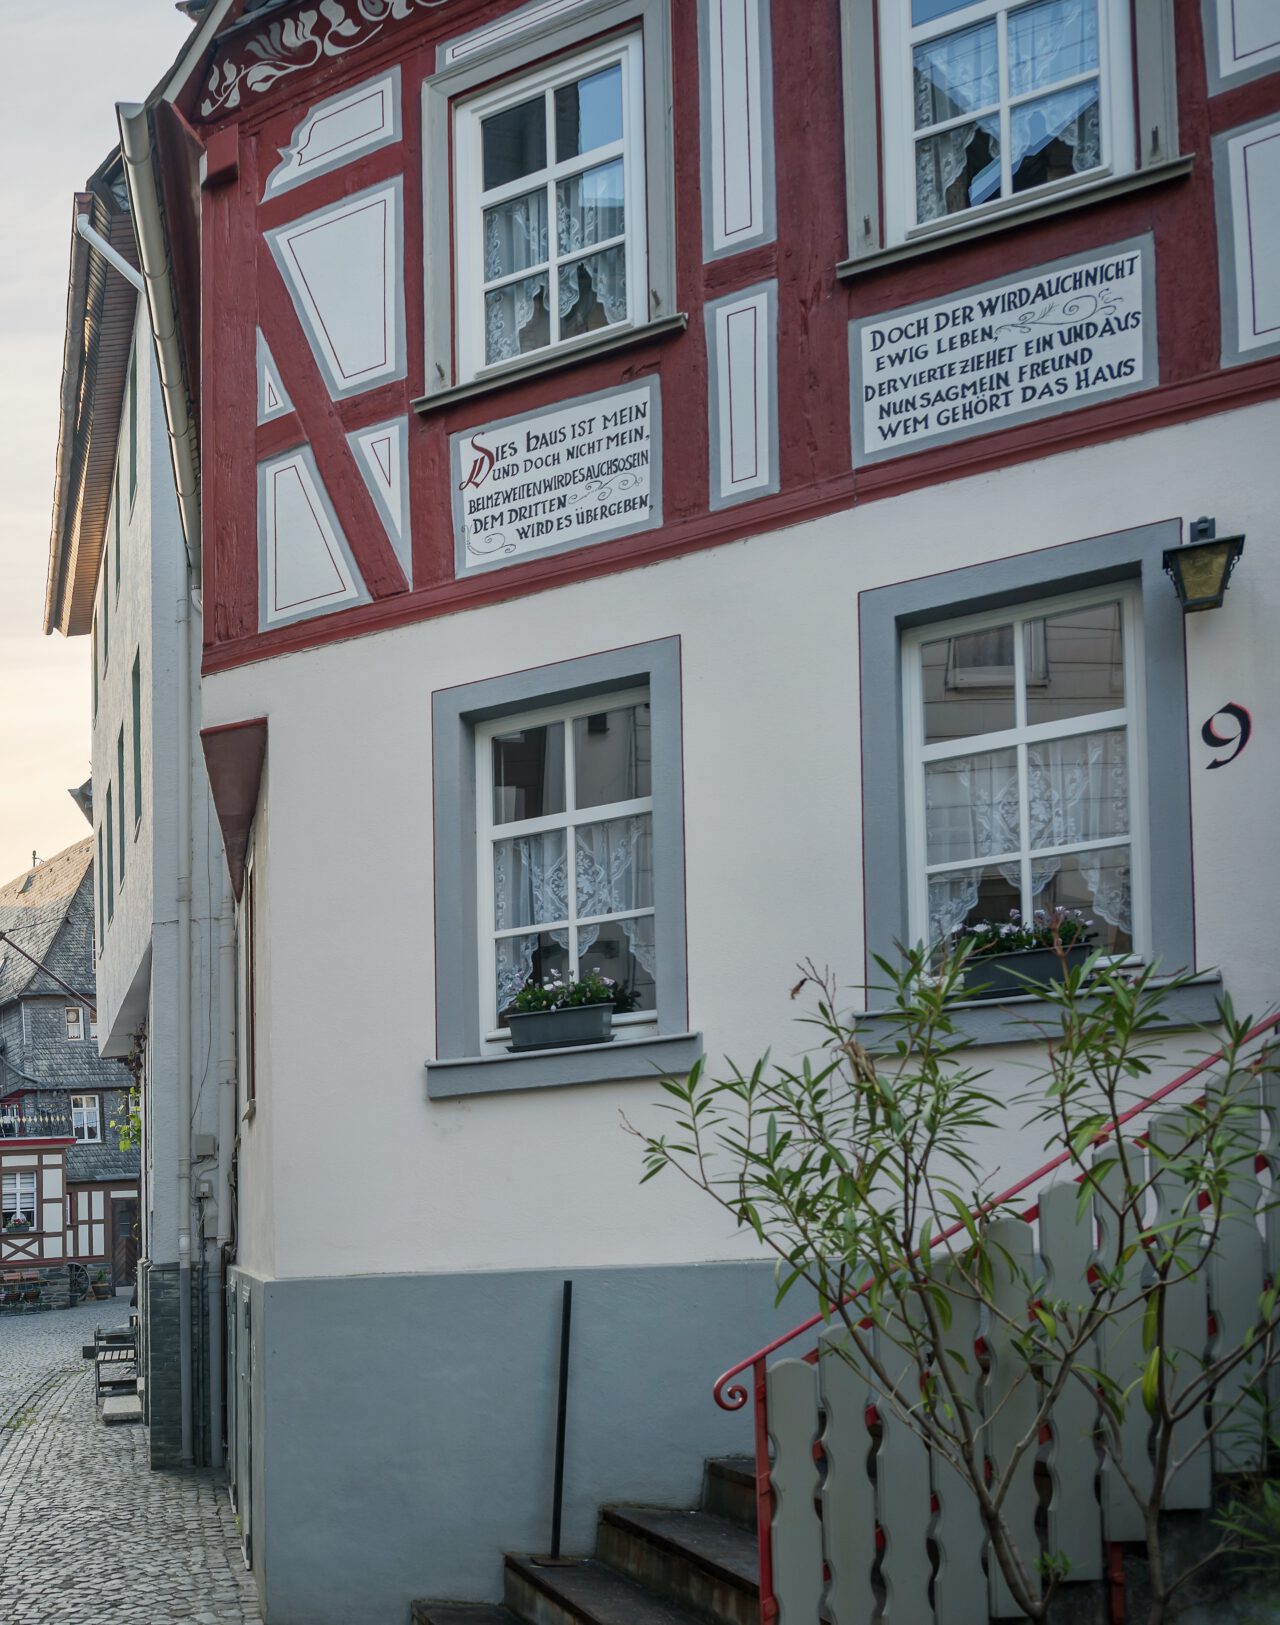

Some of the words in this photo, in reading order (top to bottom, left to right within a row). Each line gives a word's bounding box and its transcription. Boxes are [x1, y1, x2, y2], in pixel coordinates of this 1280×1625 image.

[869, 317, 929, 352] DOCH
[933, 305, 975, 333] DER
[977, 286, 1031, 319] WIRD
[1029, 269, 1084, 305] AUCH
[1085, 254, 1140, 288] NICHT
[864, 378, 899, 402] DER
[899, 362, 957, 389] VIERTE
[958, 344, 1018, 375] ZIEHET
[1024, 333, 1054, 357] EIN
[1057, 321, 1098, 346] UND
[1098, 311, 1142, 338] AUS
[875, 344, 929, 372] EWIG
[936, 325, 998, 355] LEBEN,
[877, 413, 929, 441] WEM
[937, 390, 1014, 426] GEHÖRT
[1021, 377, 1069, 404] DAS
[1075, 358, 1136, 391] HAUS
[879, 395, 917, 420] NUN
[920, 385, 960, 408] SAG
[960, 371, 1011, 399] MEIN
[1018, 347, 1093, 383] FREUND
[570, 417, 596, 440] IST
[602, 401, 648, 430] MEIN
[492, 463, 519, 481] UND
[523, 452, 561, 473] DOCH
[566, 439, 603, 461] NICHT
[606, 425, 650, 450] MEIN,
[472, 511, 504, 535] DEM
[507, 494, 568, 524] DRITTEN
[516, 519, 554, 540] WIRD
[556, 514, 573, 532] ES
[575, 494, 654, 525] ÜBERGEBEN,
[1201, 701, 1252, 770] 9
